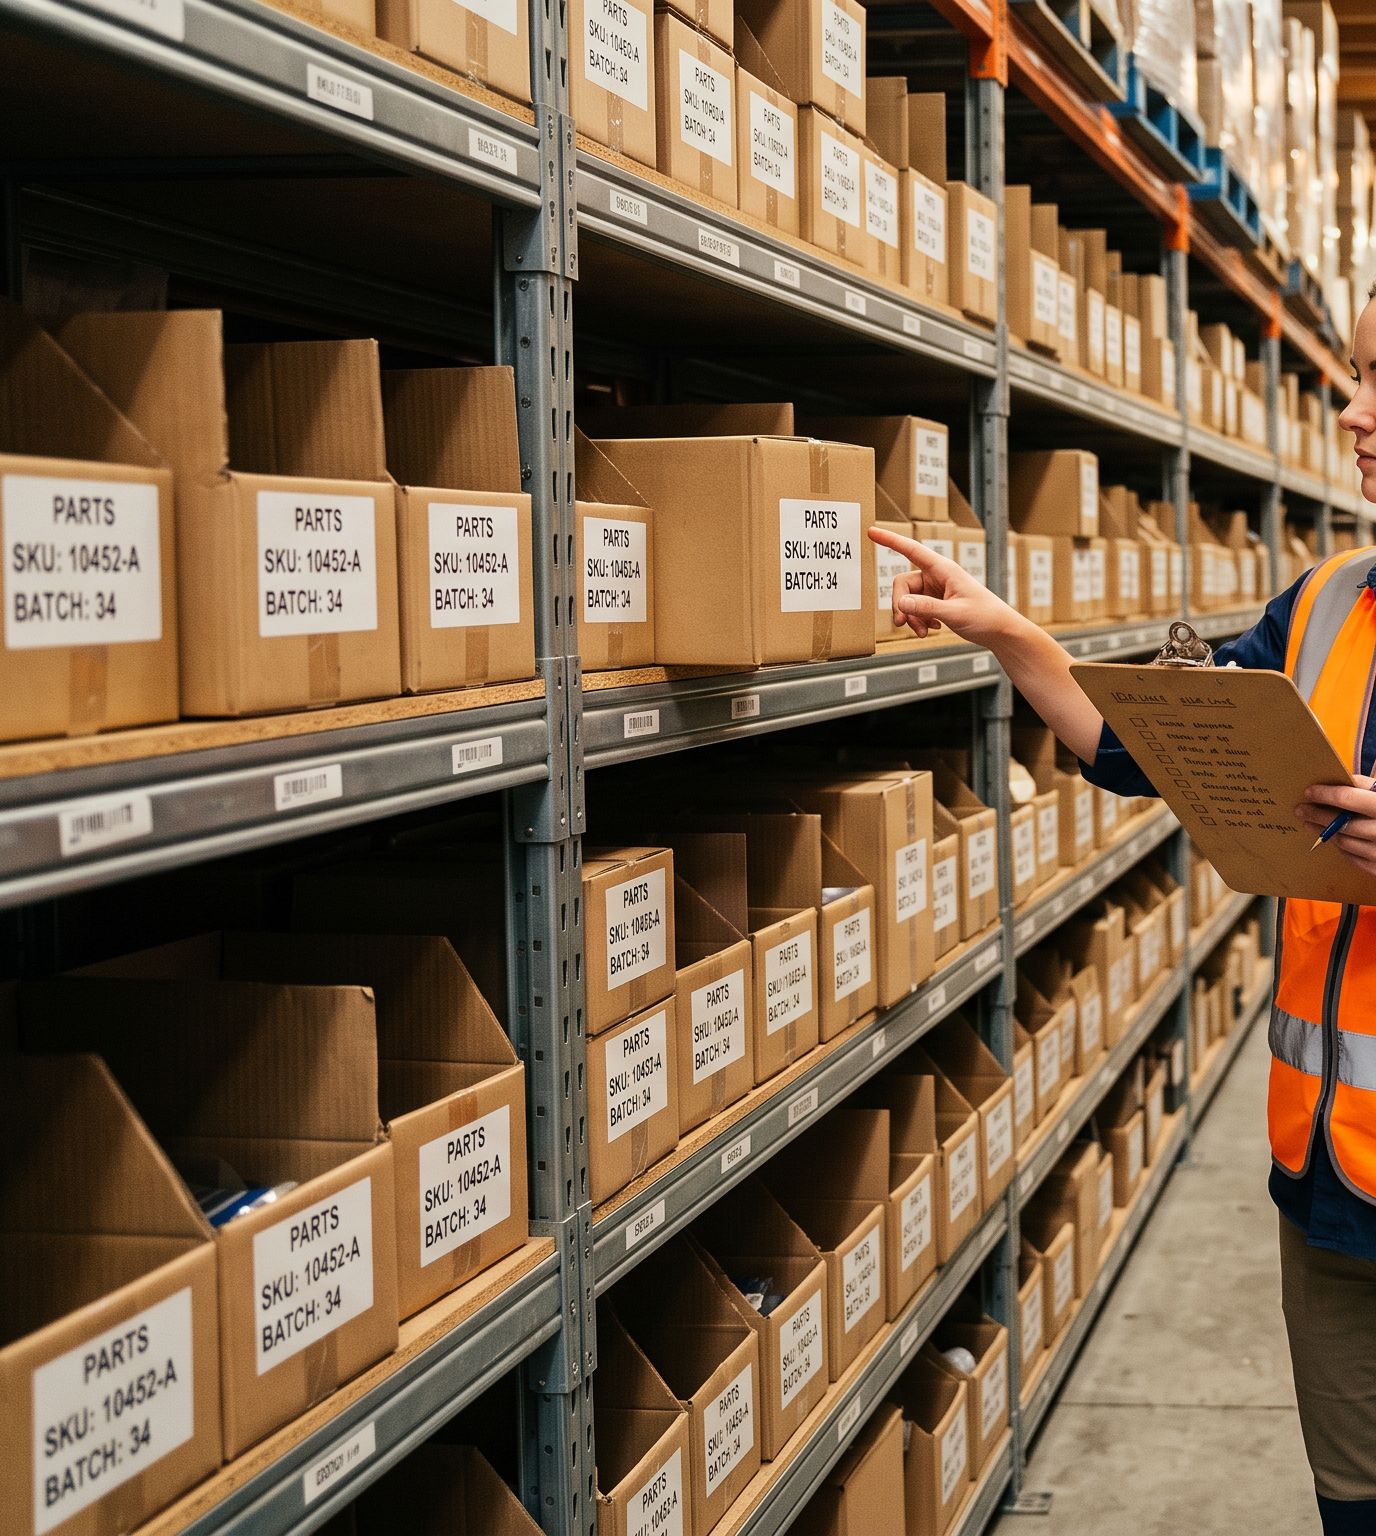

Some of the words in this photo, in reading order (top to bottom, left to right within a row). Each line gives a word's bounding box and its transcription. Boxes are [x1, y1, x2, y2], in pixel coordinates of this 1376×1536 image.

[603, 0, 628, 27] PARTS
[695, 67, 715, 93] PARTS
[52, 495, 116, 527] PARTS
[295, 507, 343, 533] PARTS
[804, 510, 838, 530] PARTS
[456, 516, 494, 538] PARTS
[603, 528, 630, 548] PARTS
[12, 542, 61, 574] SKU:
[69, 544, 140, 573] 10452-A
[264, 548, 301, 574] SKU:
[307, 549, 362, 573] 10452-A
[434, 552, 462, 574] SKU:
[466, 552, 509, 574] 10452-A
[784, 540, 810, 559] SKU:
[587, 558, 609, 578] SKU:
[785, 571, 824, 591] BATCH:
[826, 571, 838, 590] 34
[14, 591, 89, 623] BATCH:
[95, 591, 117, 620] 34
[266, 589, 322, 616] BATCH:
[327, 589, 343, 613] 34
[435, 587, 478, 611] BATCH:
[481, 587, 494, 609] 34
[587, 589, 620, 608] BATCH:
[621, 590, 631, 608] 34
[623, 882, 649, 909] PARTS
[609, 921, 629, 945] SKU:
[706, 983, 730, 1009] PARTS
[623, 1027, 650, 1058] PARTS
[609, 1071, 630, 1097] SKU:
[447, 1126, 485, 1164] PARTS
[424, 1179, 453, 1213] SKU:
[290, 1204, 339, 1253] PARTS
[425, 1206, 470, 1249] BATCH:
[473, 1194, 487, 1221] 34
[261, 1271, 299, 1311] SKU:
[304, 1236, 361, 1286] 10452-A
[262, 1299, 320, 1353] BATCH:
[325, 1284, 342, 1316] 34
[83, 1324, 149, 1384] PARTS
[44, 1407, 94, 1458] SKU:
[103, 1358, 178, 1423] 10452-A
[44, 1439, 123, 1508] BATCH:
[129, 1418, 151, 1456] 34
[642, 1472, 667, 1514] PARTS
